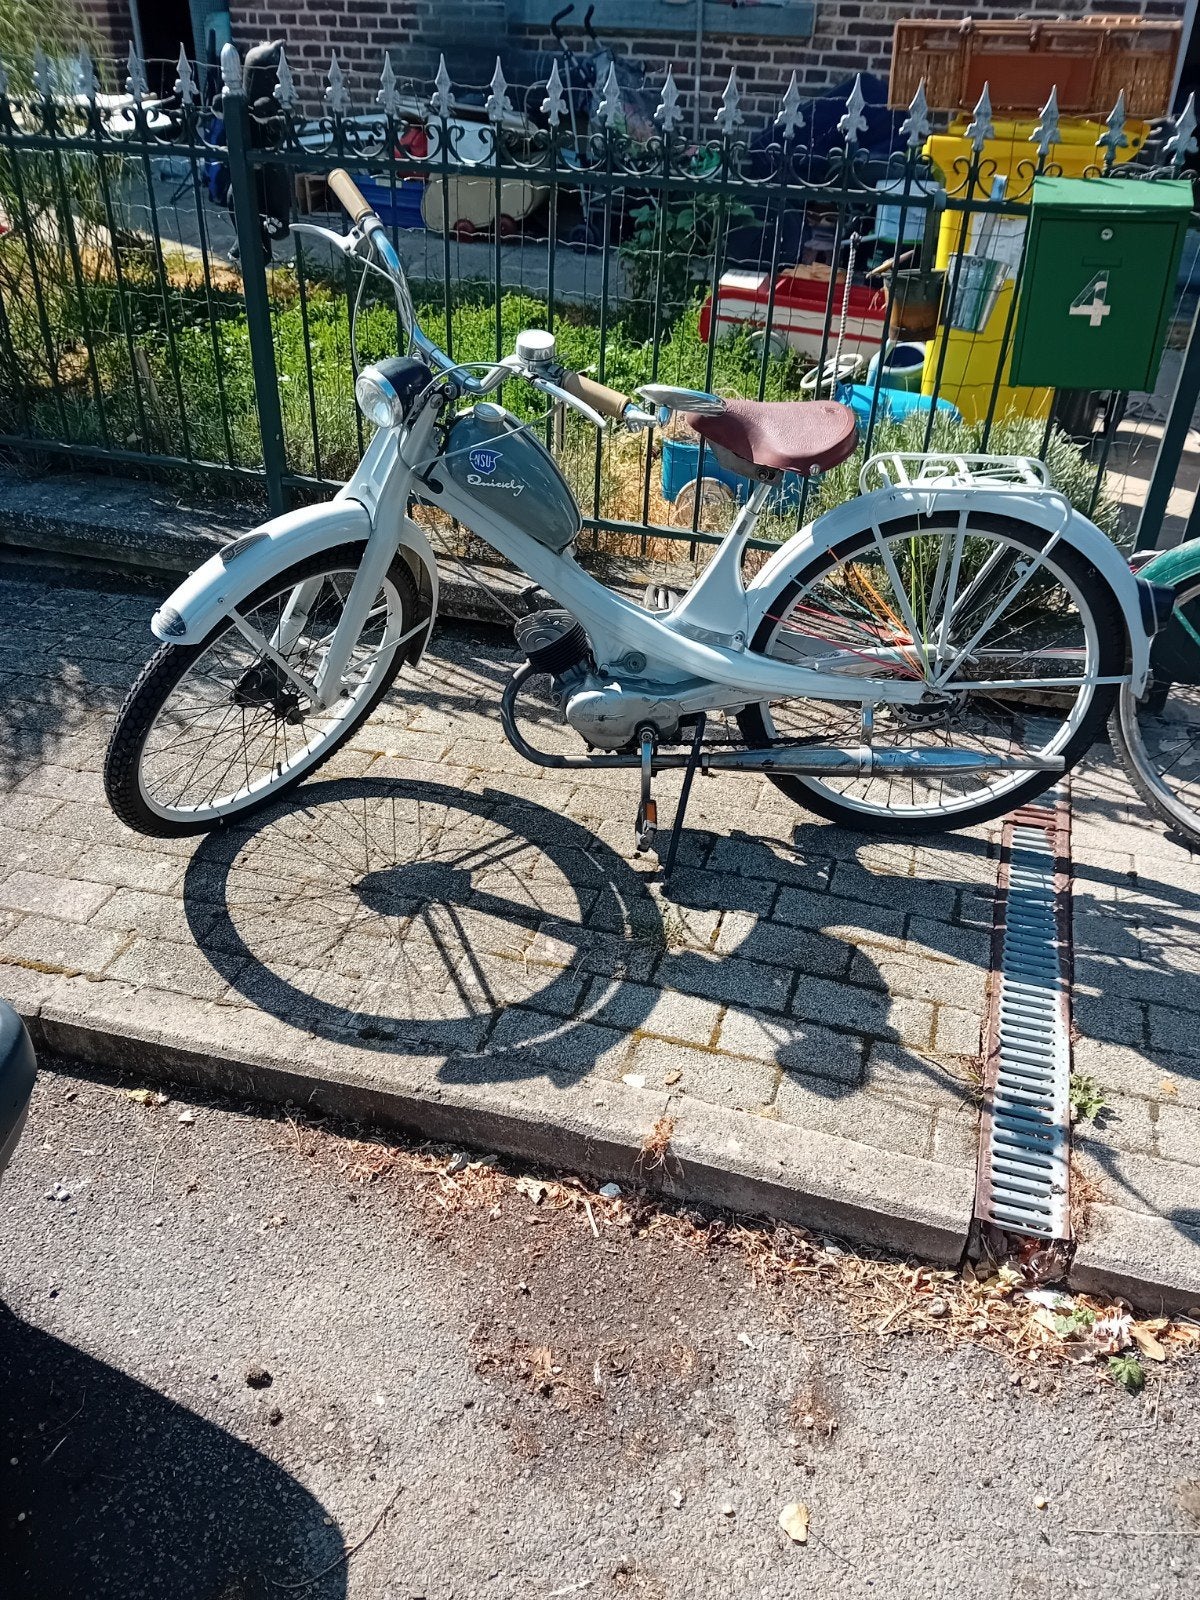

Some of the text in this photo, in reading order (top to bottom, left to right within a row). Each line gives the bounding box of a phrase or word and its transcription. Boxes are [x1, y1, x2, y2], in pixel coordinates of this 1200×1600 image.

[1069, 269, 1111, 326] 4
[474, 454, 492, 468] NSU
[466, 474, 525, 497] Quickly
